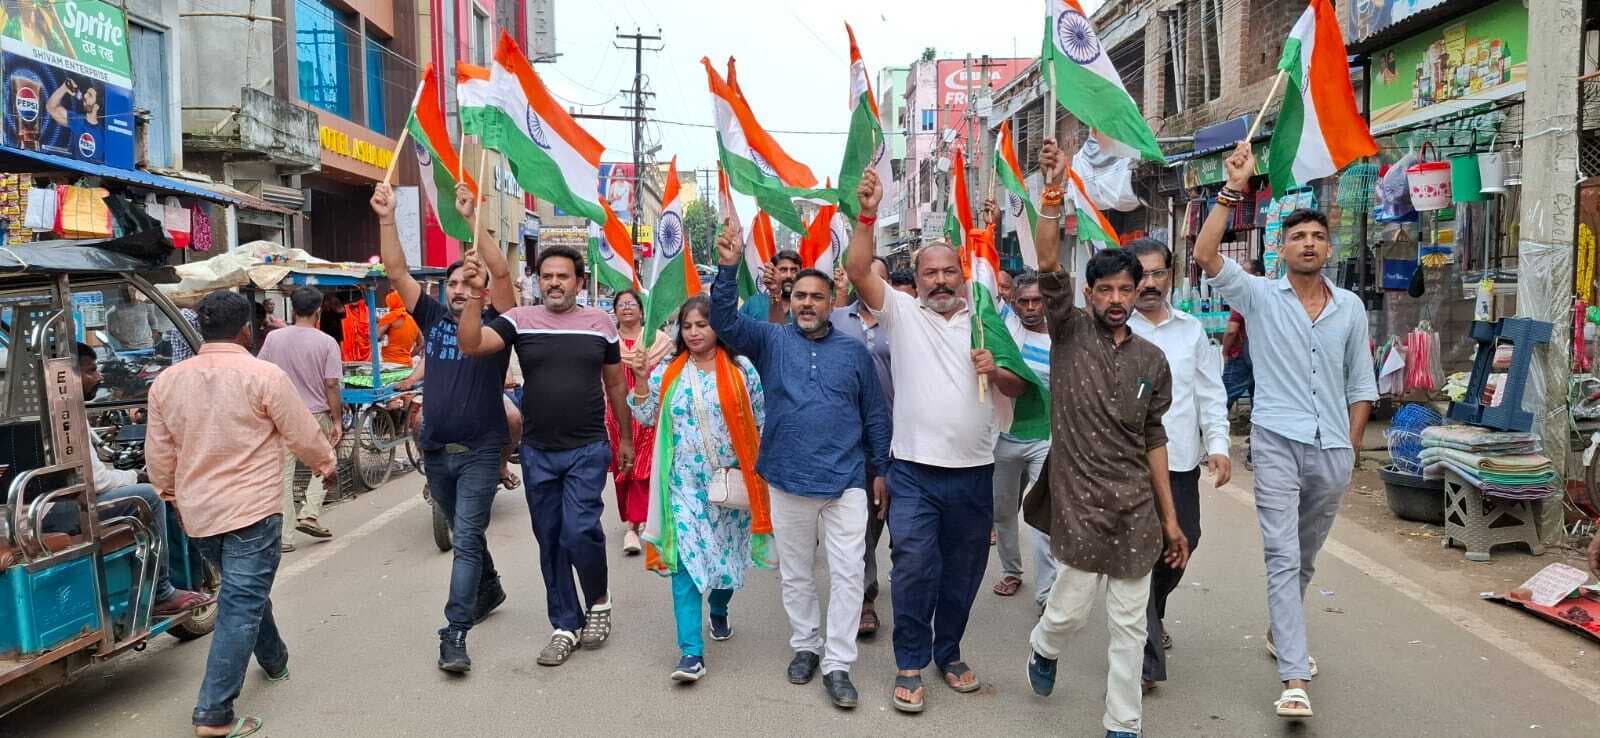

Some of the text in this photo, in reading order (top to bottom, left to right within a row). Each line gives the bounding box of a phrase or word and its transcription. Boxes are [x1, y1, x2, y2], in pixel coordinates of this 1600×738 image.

[64, 1, 122, 46] Sprite
[32, 48, 111, 81] SHIVAM ENTERPRISE
[17, 98, 38, 110] PEPSI
[320, 126, 351, 157] OTEL
